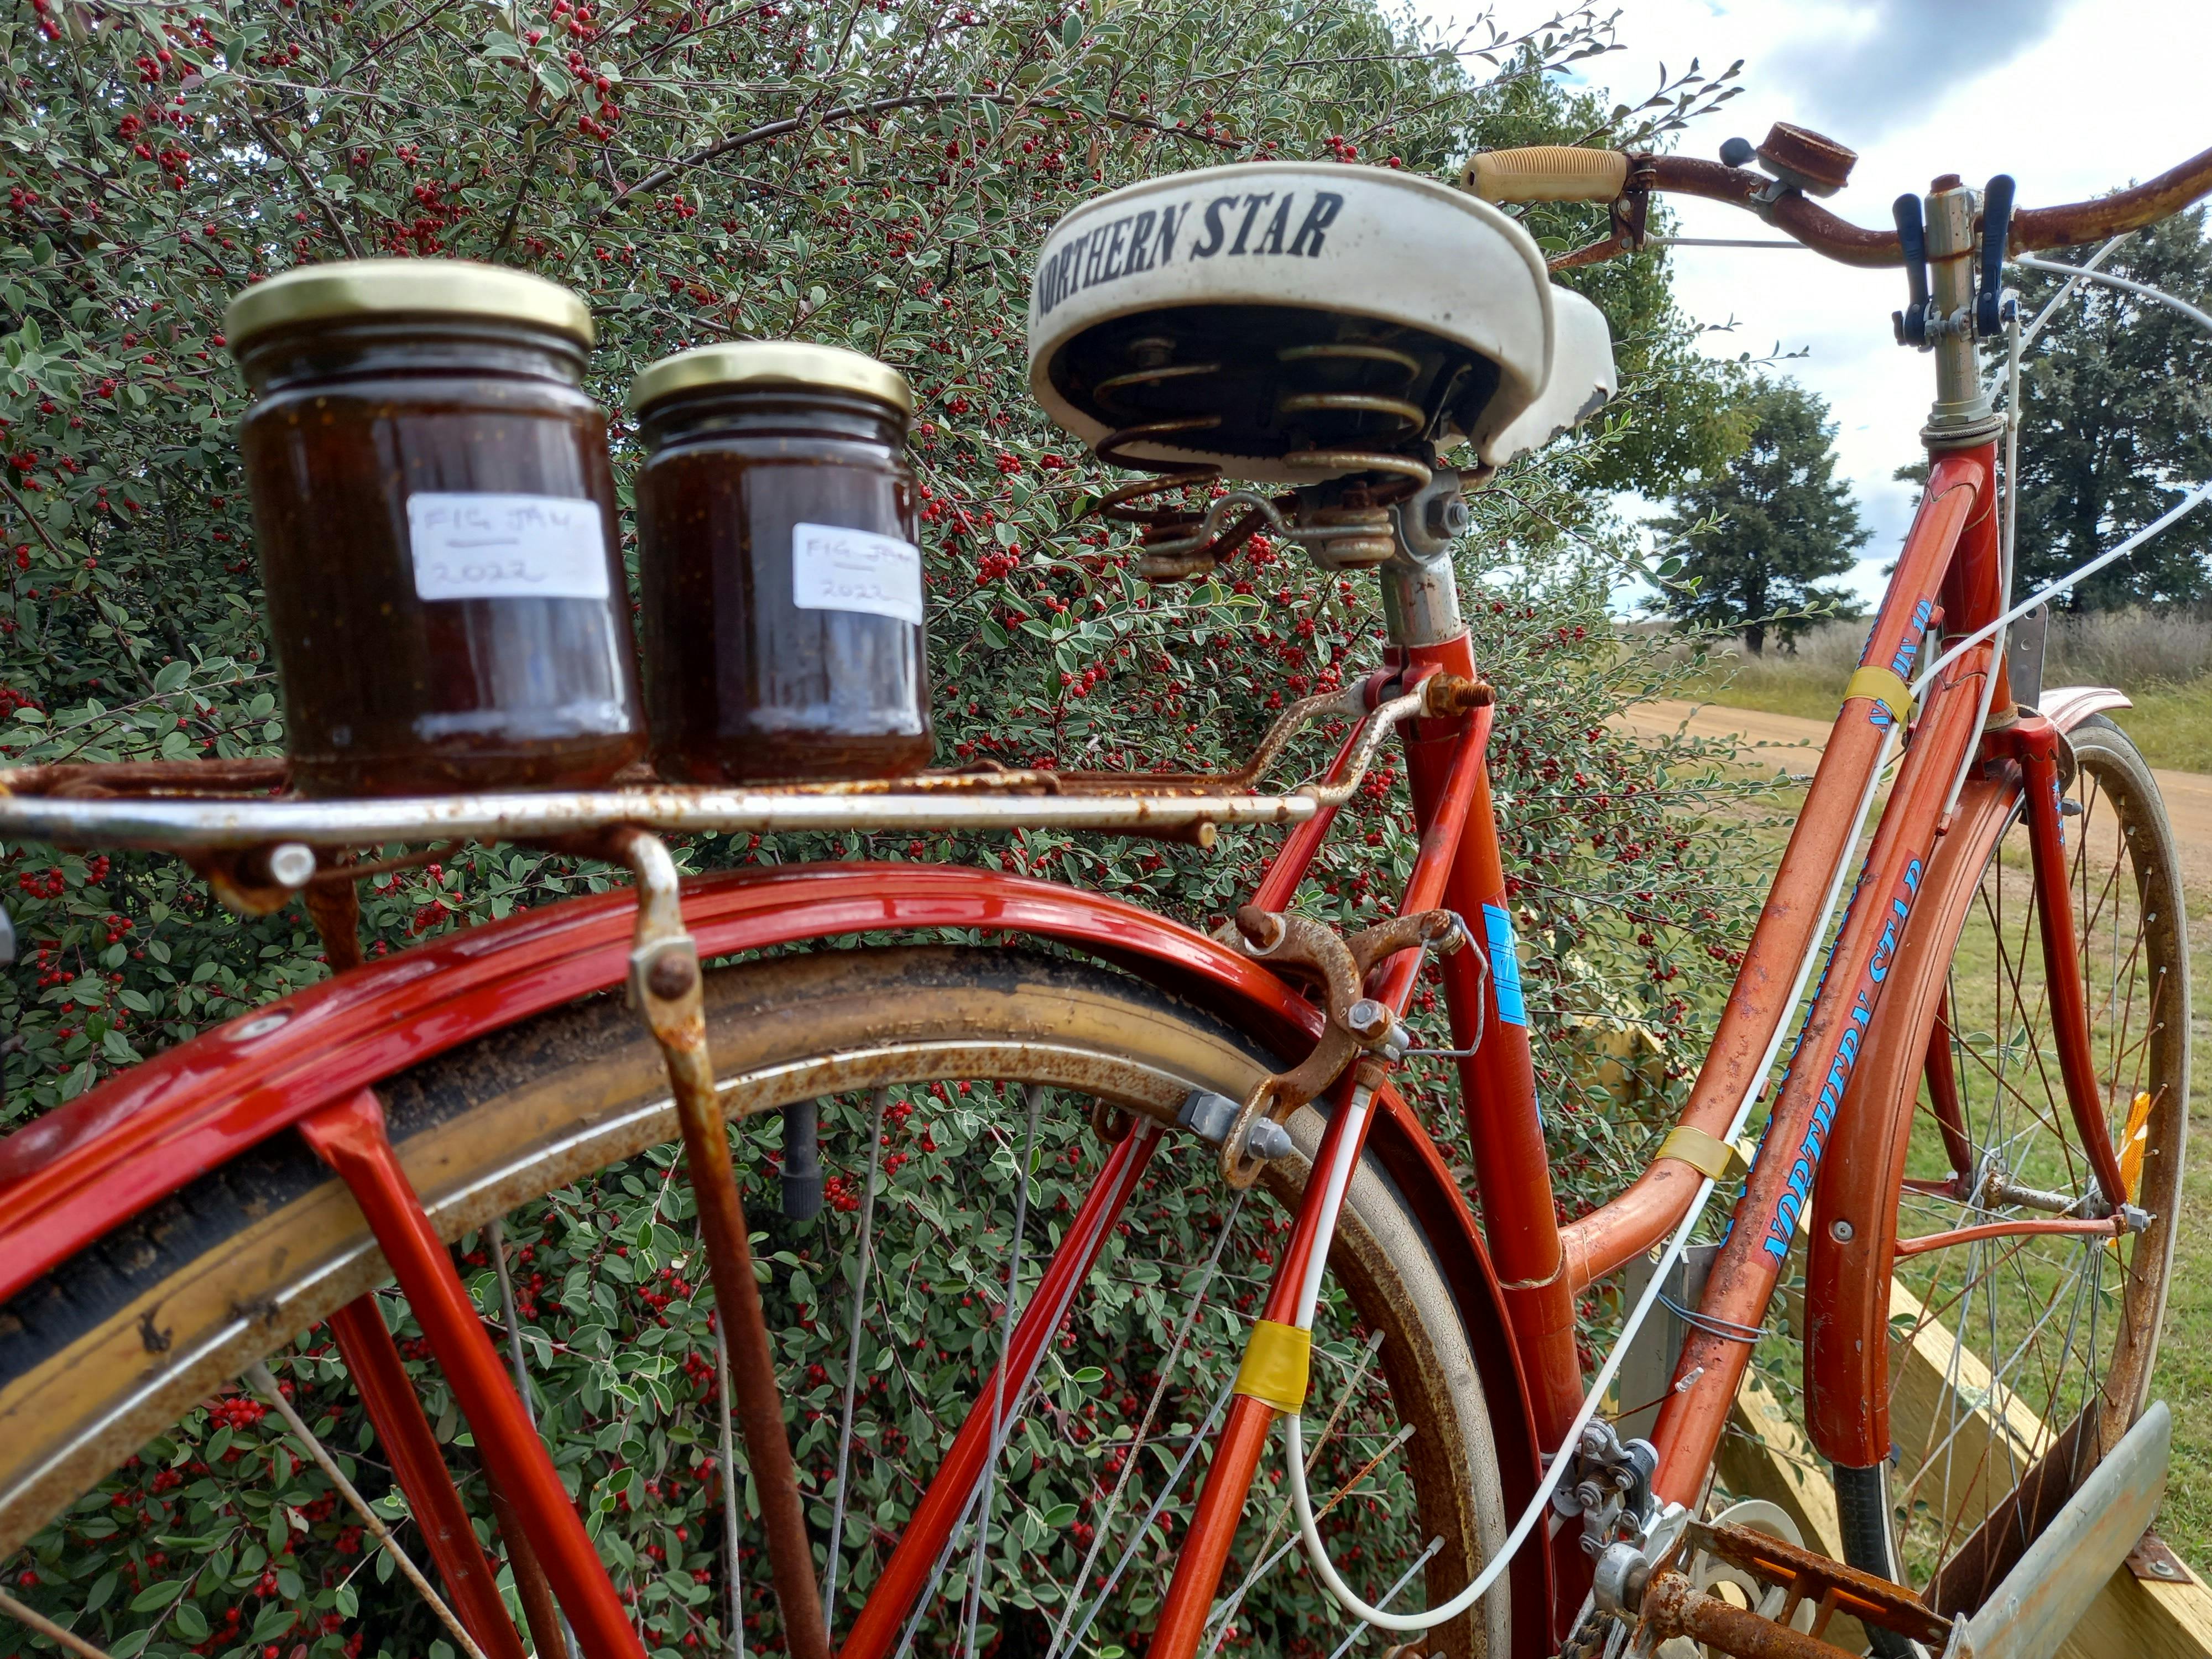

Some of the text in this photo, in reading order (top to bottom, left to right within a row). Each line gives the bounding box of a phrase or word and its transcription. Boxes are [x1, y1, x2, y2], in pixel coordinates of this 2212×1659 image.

[1036, 191, 1344, 327] NORTHERN STAR
[1762, 989, 1871, 1270] NORTHERN
